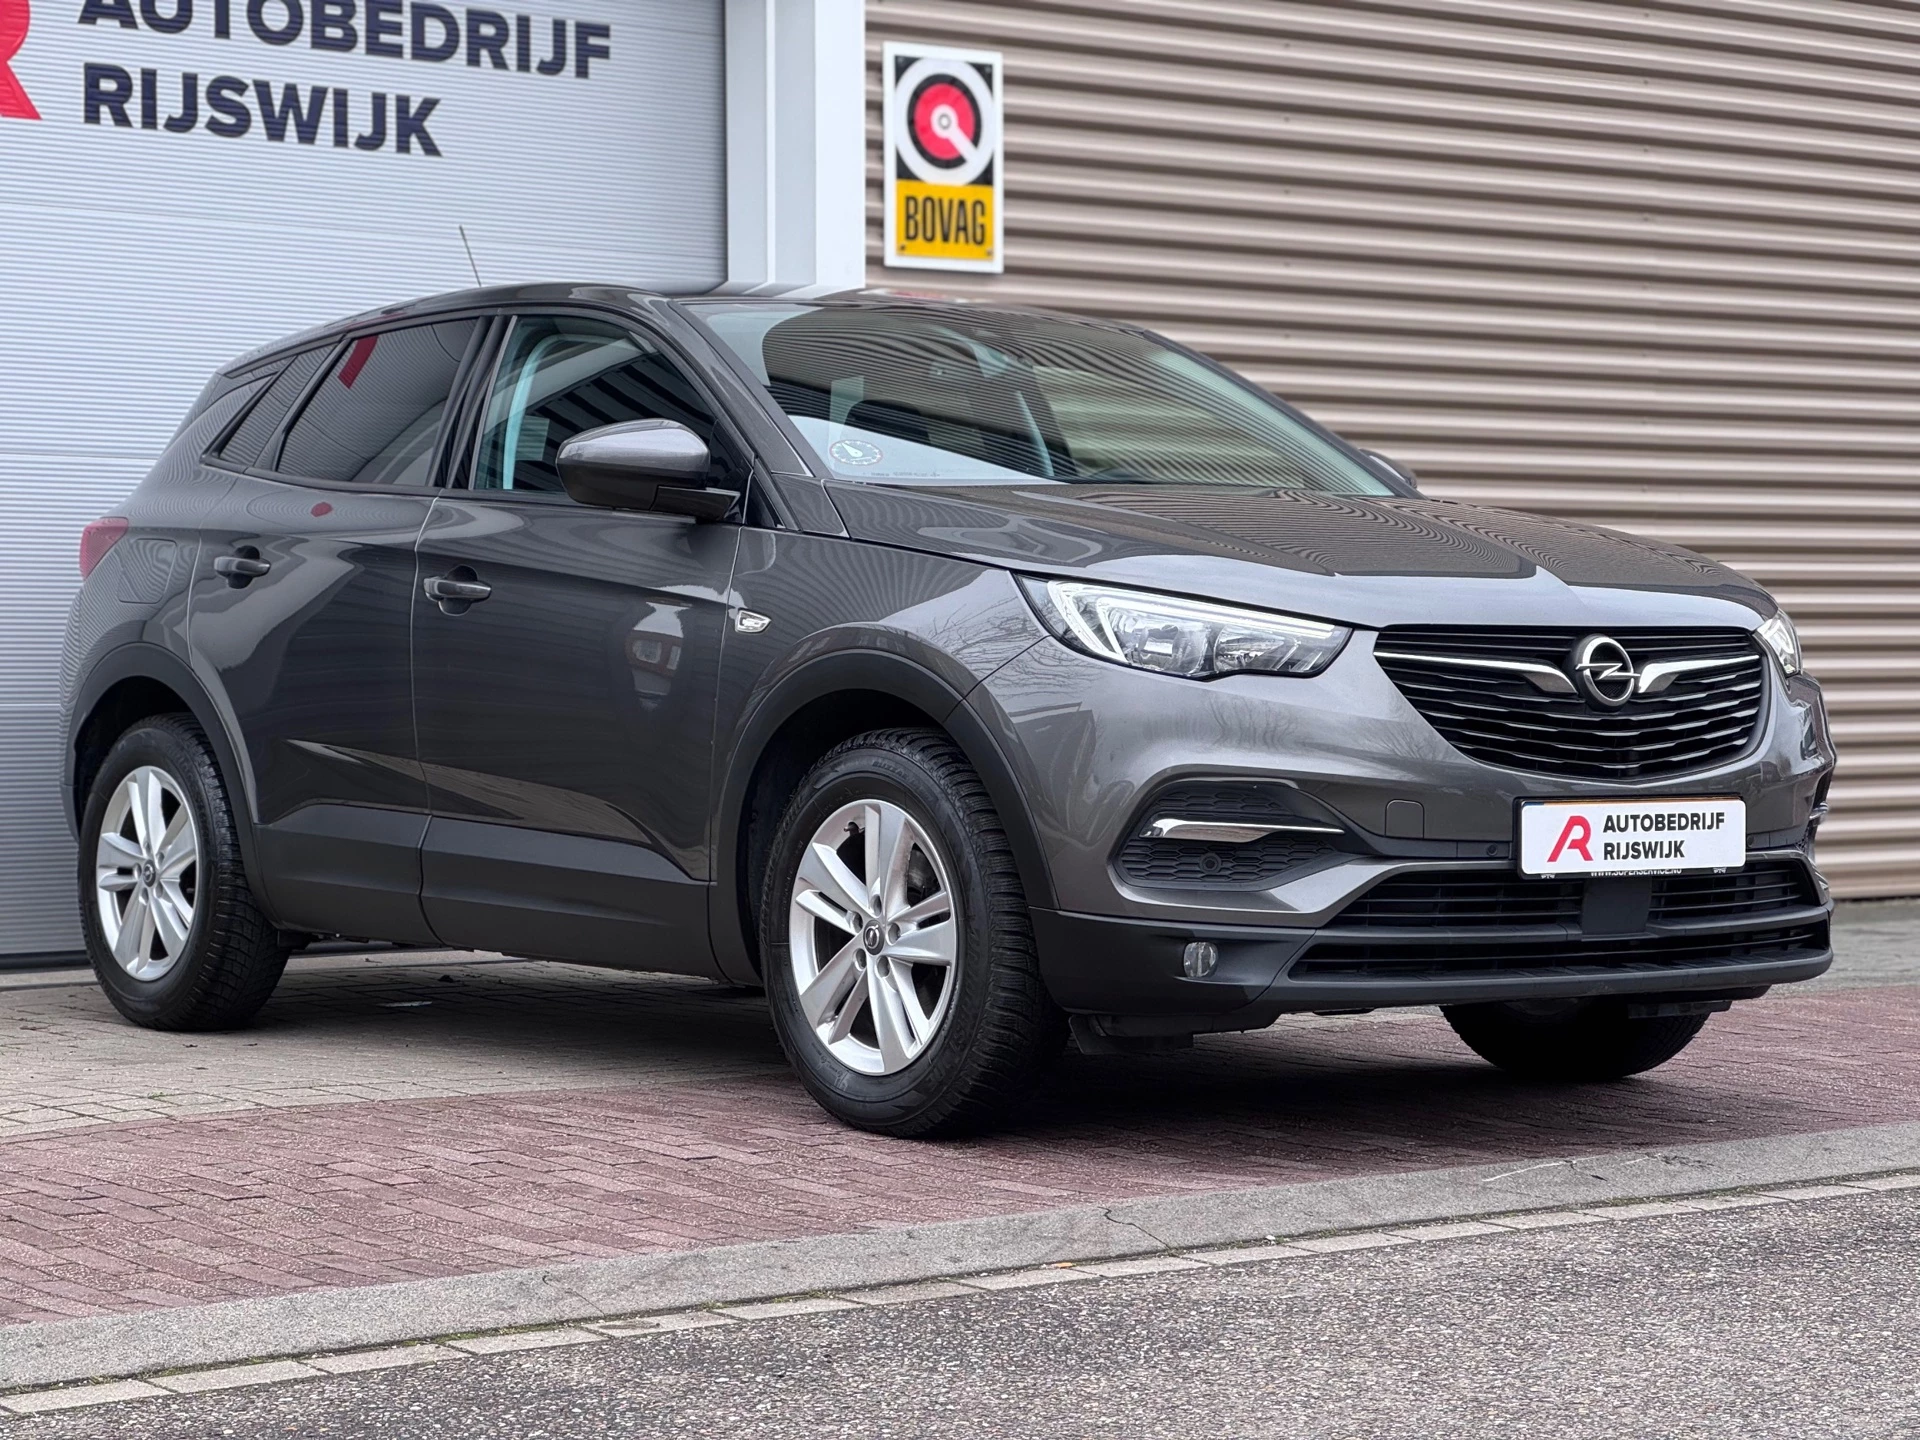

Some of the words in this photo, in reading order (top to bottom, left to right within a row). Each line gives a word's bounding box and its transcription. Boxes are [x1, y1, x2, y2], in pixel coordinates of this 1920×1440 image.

[83, 62, 443, 157] RIJSWIJK
[904, 196, 985, 246] BOVAG
[1602, 811, 1726, 834] AUTOBEDRIJF
[1603, 839, 1686, 861] RIJSWIJK
